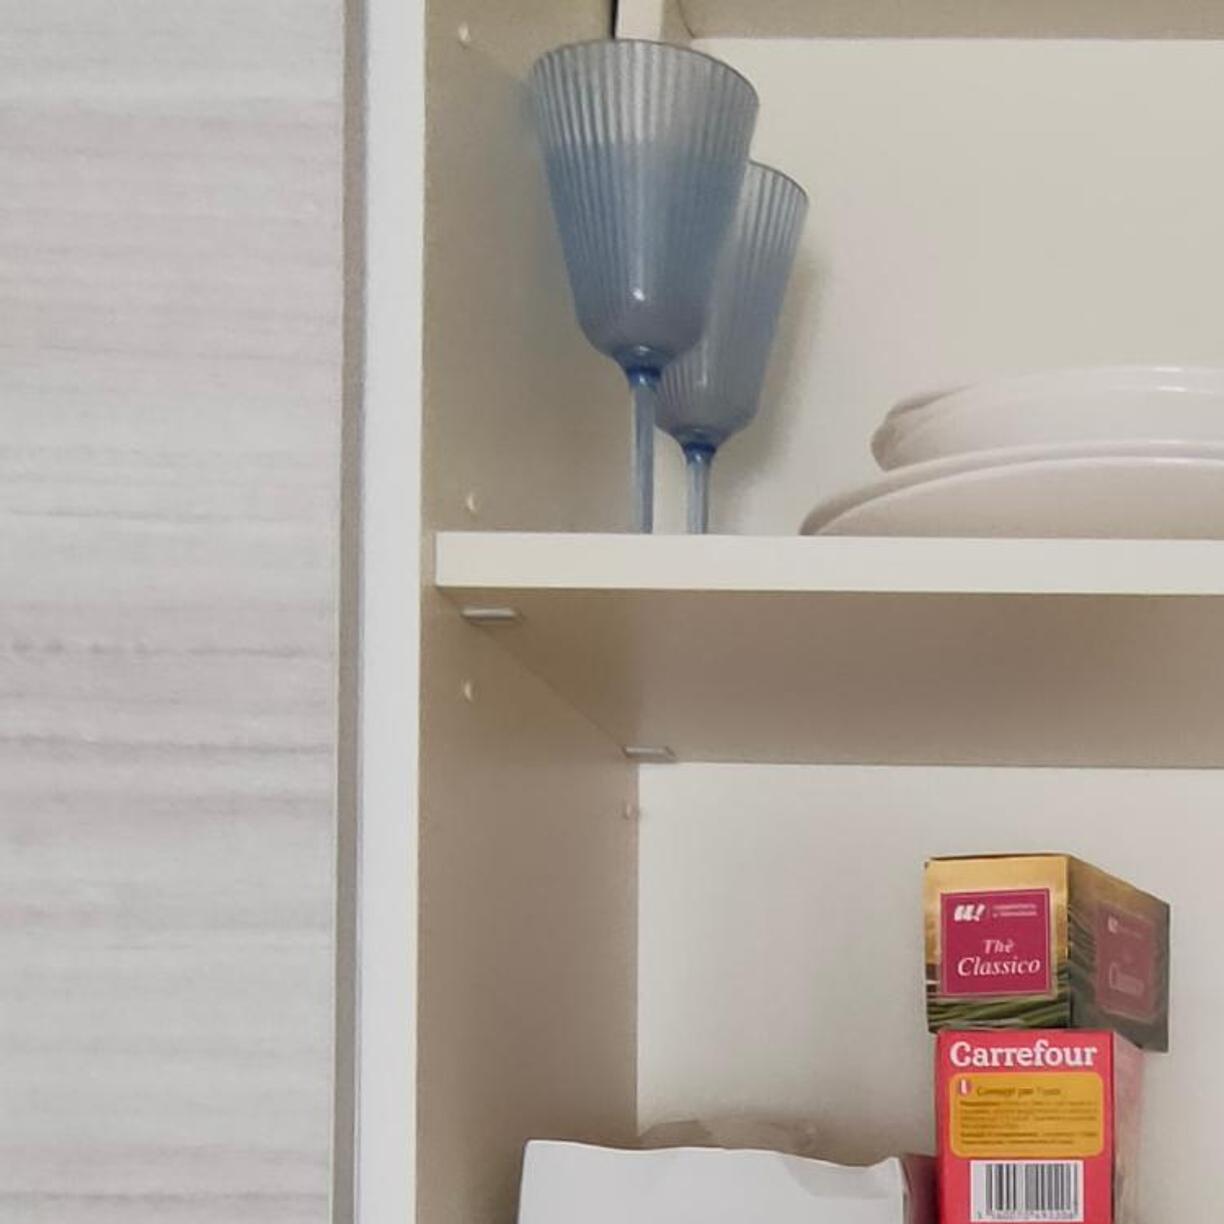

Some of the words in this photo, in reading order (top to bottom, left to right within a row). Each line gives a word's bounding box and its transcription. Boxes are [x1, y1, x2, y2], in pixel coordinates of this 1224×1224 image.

[983, 938, 1016, 955] Thè
[957, 956, 1041, 978] Classico
[949, 1039, 1098, 1068] Carrefour
